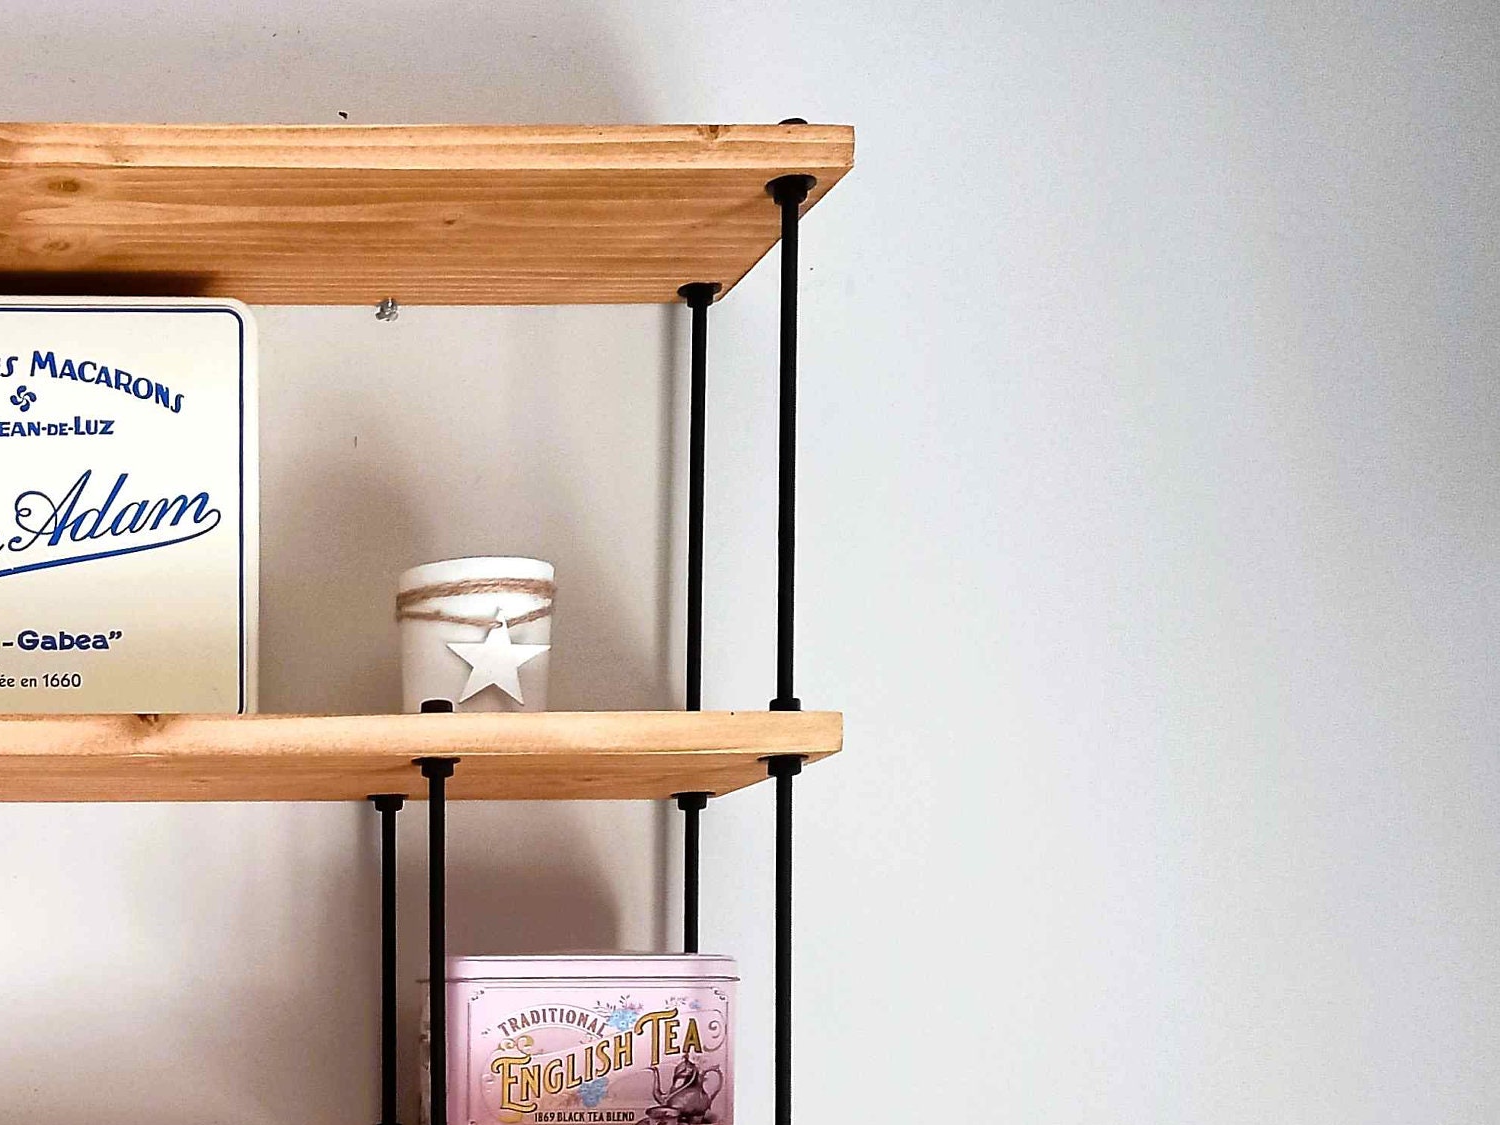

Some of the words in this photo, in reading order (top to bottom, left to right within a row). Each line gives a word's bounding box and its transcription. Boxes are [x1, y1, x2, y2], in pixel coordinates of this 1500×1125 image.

[29, 350, 185, 414] MACARONS
[8, 469, 222, 552] Adam
[20, 676, 37, 688] en
[42, 673, 82, 689] 1660
[497, 1007, 609, 1039] TRADITIONAL
[490, 1030, 633, 1113] ENGLISH
[633, 1007, 703, 1068] TEA
[534, 1111, 555, 1122] 1869
[557, 1111, 585, 1122] BLACK
[587, 1111, 604, 1122] TEA
[606, 1110, 635, 1122] BLEND
